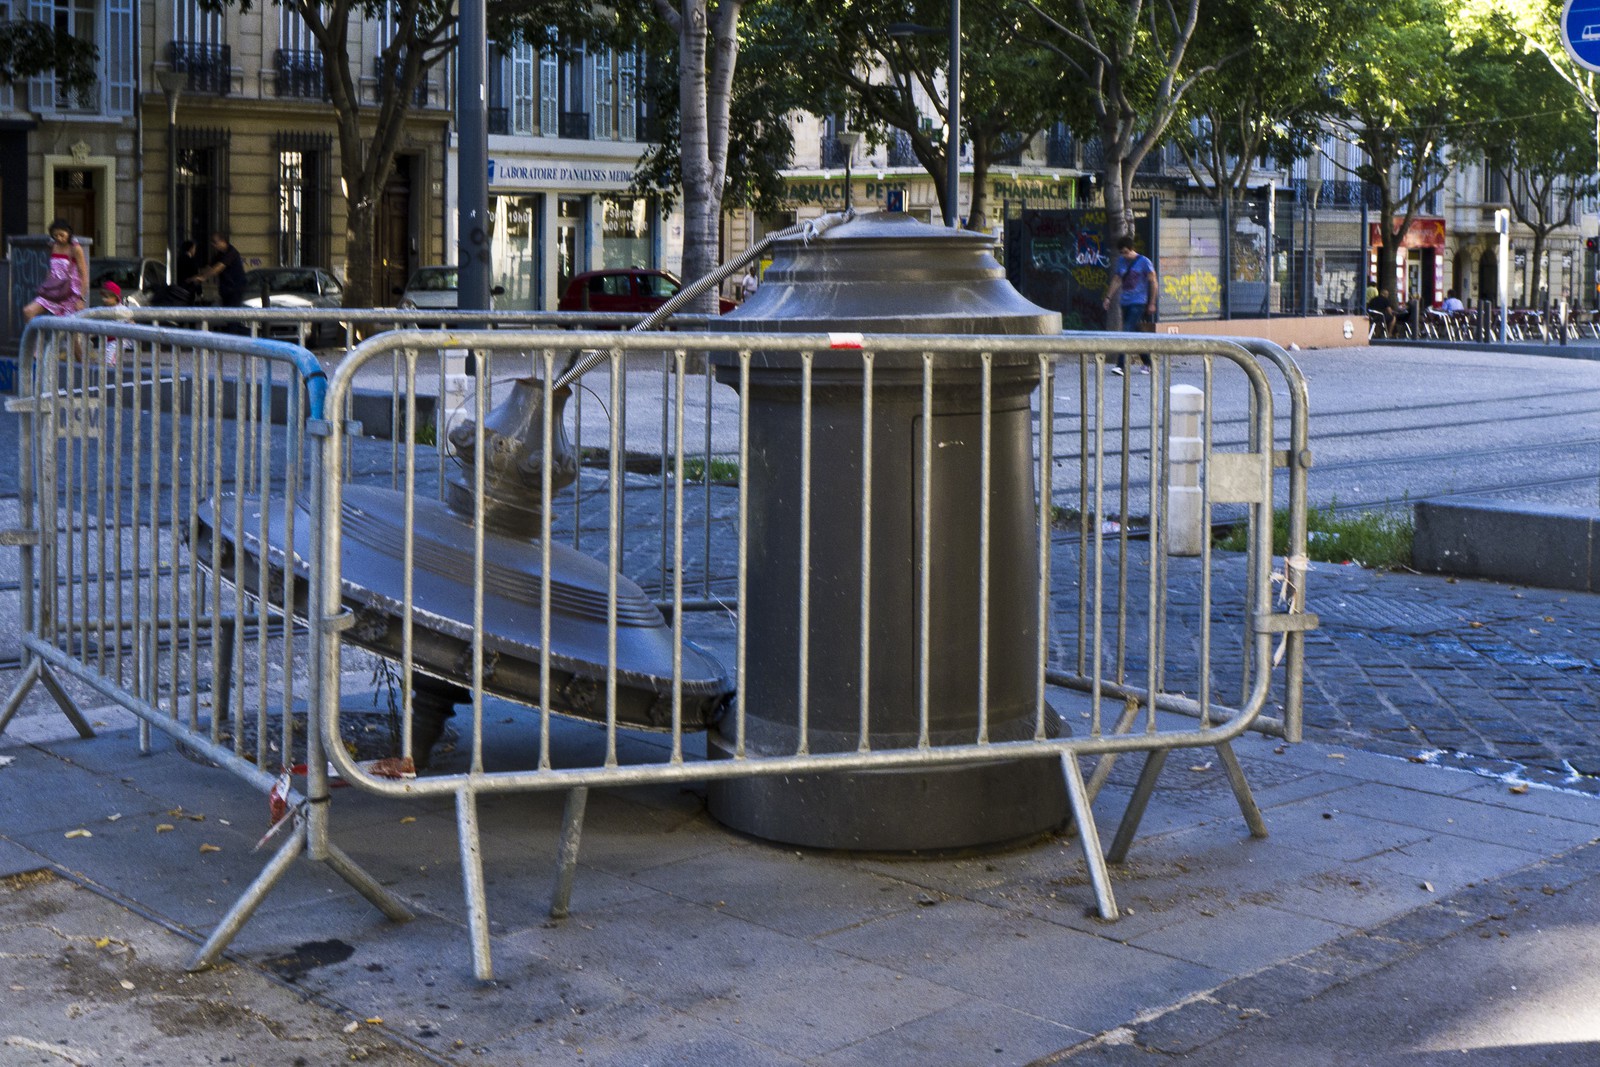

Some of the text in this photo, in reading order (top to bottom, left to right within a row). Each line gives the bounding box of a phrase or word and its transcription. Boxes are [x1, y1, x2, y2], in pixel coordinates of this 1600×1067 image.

[500, 165, 558, 180] LABORATOIRE
[560, 167, 607, 183] D'ANALYSES
[779, 182, 854, 201] ARMACI
[993, 181, 1069, 200] PHARMACIE
[508, 210, 532, 223] 19h0
